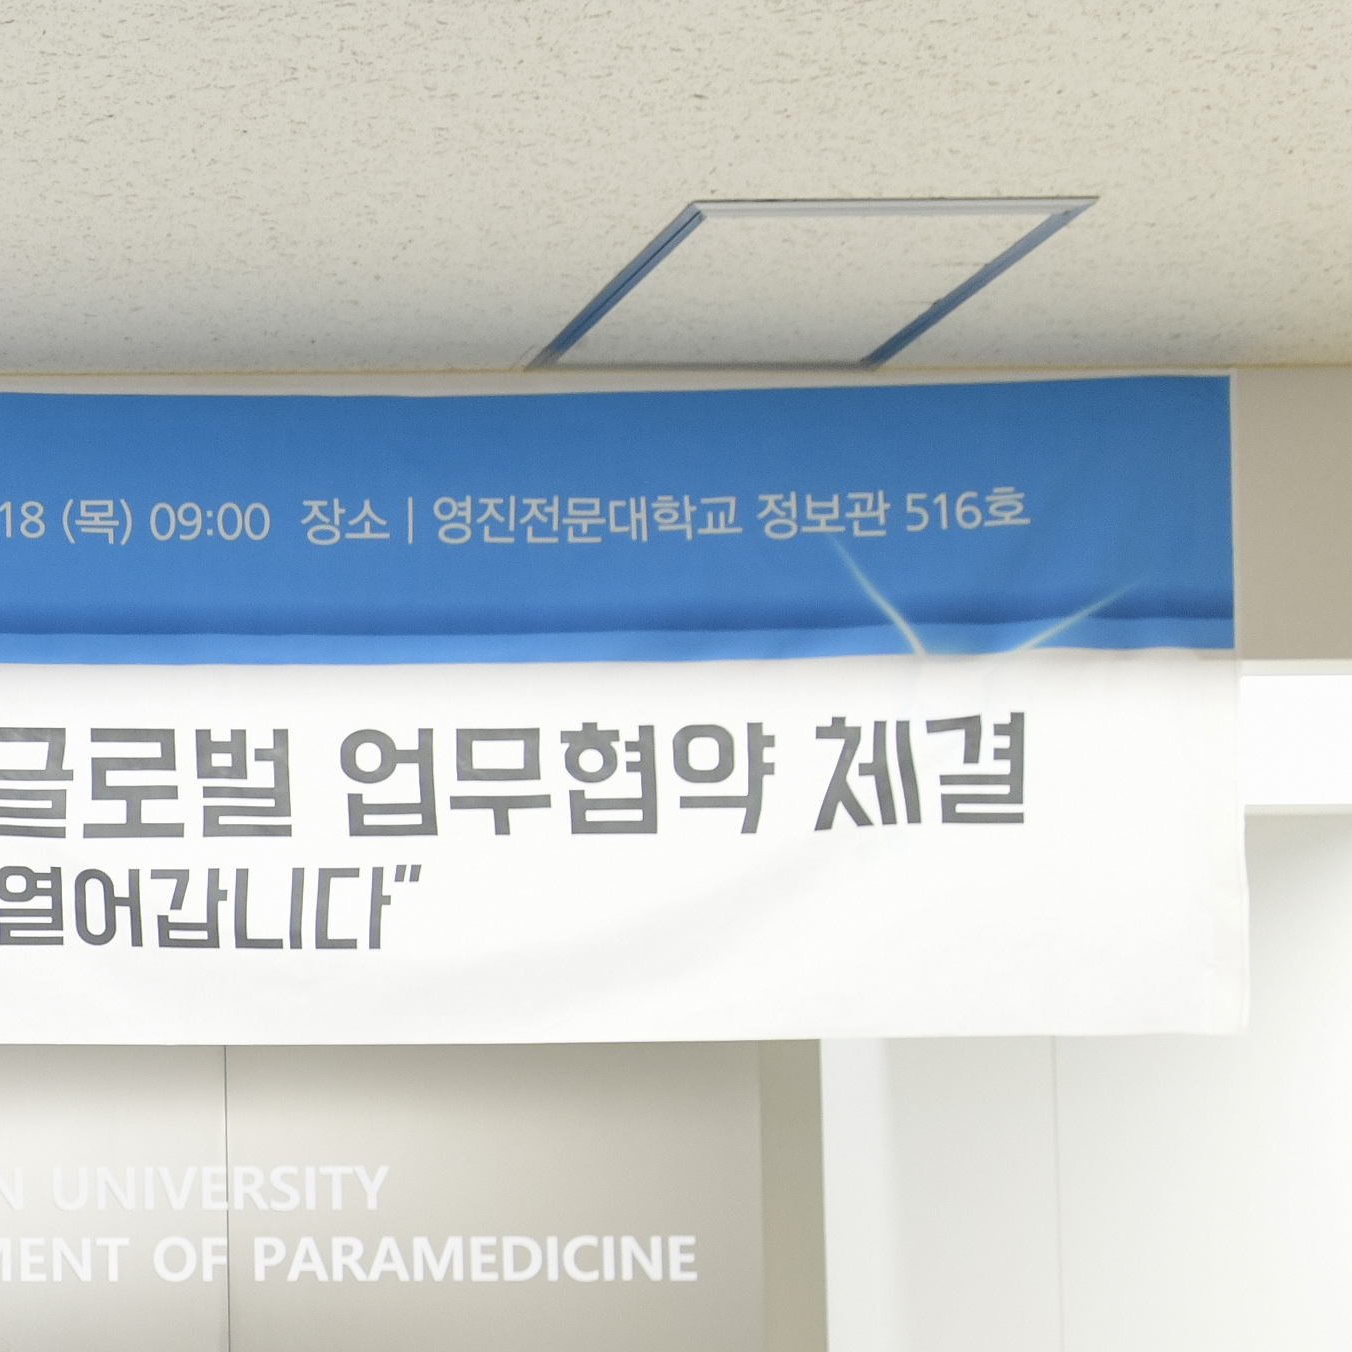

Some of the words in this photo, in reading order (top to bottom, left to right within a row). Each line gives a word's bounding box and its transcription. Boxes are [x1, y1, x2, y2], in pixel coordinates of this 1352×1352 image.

[61, 498, 133, 546] (목)
[149, 502, 271, 541] 09:00
[300, 498, 391, 546] 장소
[432, 495, 744, 545] 영진전문대학교
[756, 490, 892, 538] 정보관
[905, 486, 1032, 532] 516호
[339, 722, 776, 837] 업무협약
[813, 711, 1026, 832] 체결
[51, 1165, 390, 1212] UNIVERSITY
[152, 1236, 229, 1283] OF
[253, 1235, 699, 1283] PARAMEDICINE
